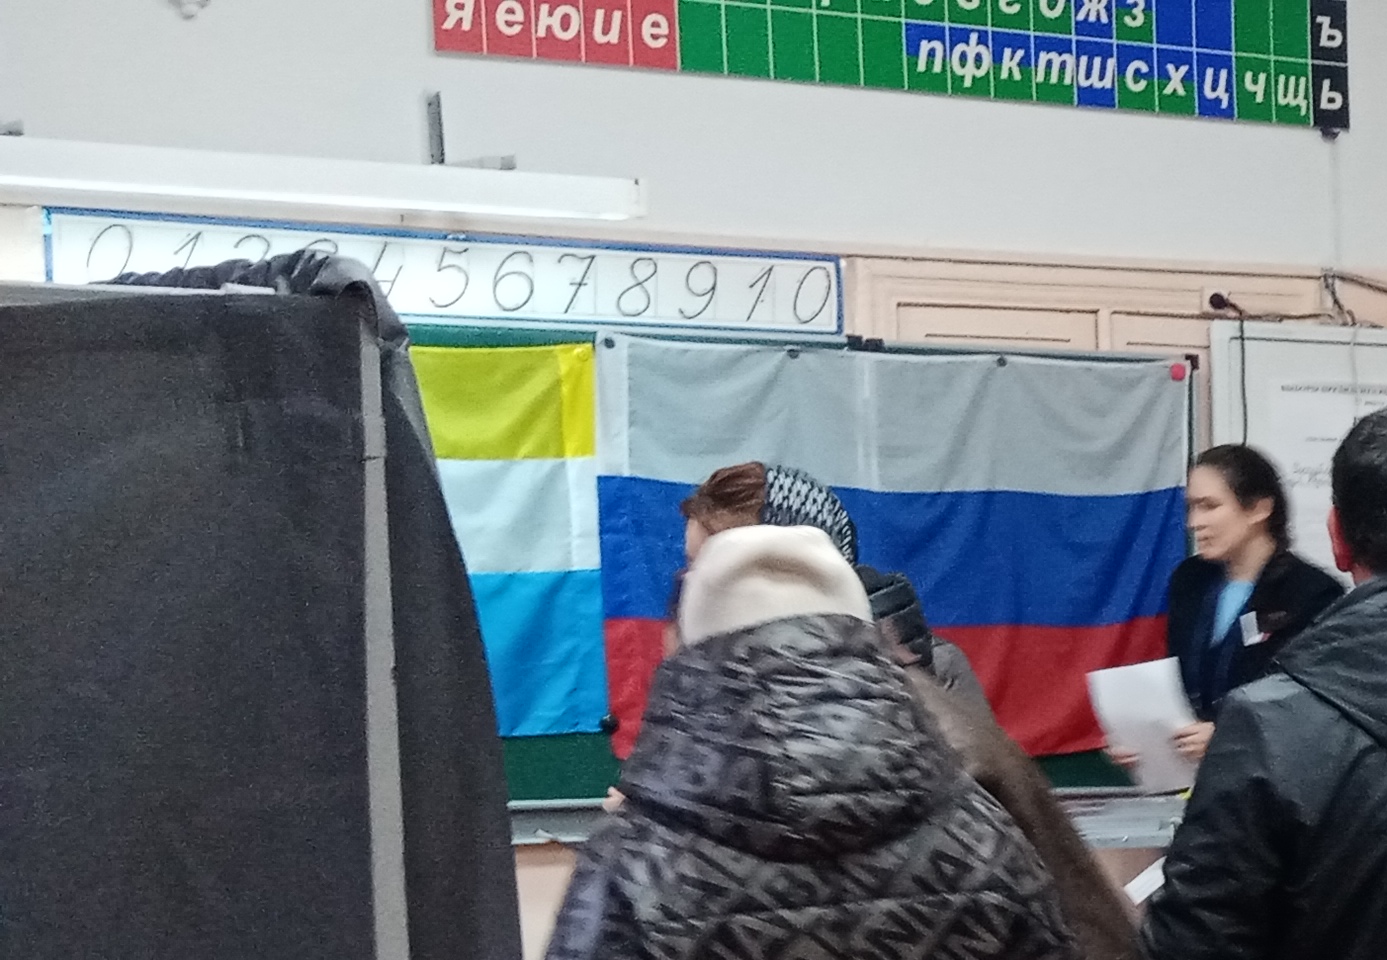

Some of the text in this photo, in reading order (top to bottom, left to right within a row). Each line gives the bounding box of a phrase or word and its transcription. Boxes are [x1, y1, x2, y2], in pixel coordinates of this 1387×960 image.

[641, 13, 669, 48] е
[430, 248, 470, 309] 5
[491, 252, 536, 312] 6
[555, 255, 598, 314] 7
[617, 257, 659, 317] 8
[678, 259, 718, 319] 9
[747, 260, 835, 326] 10
